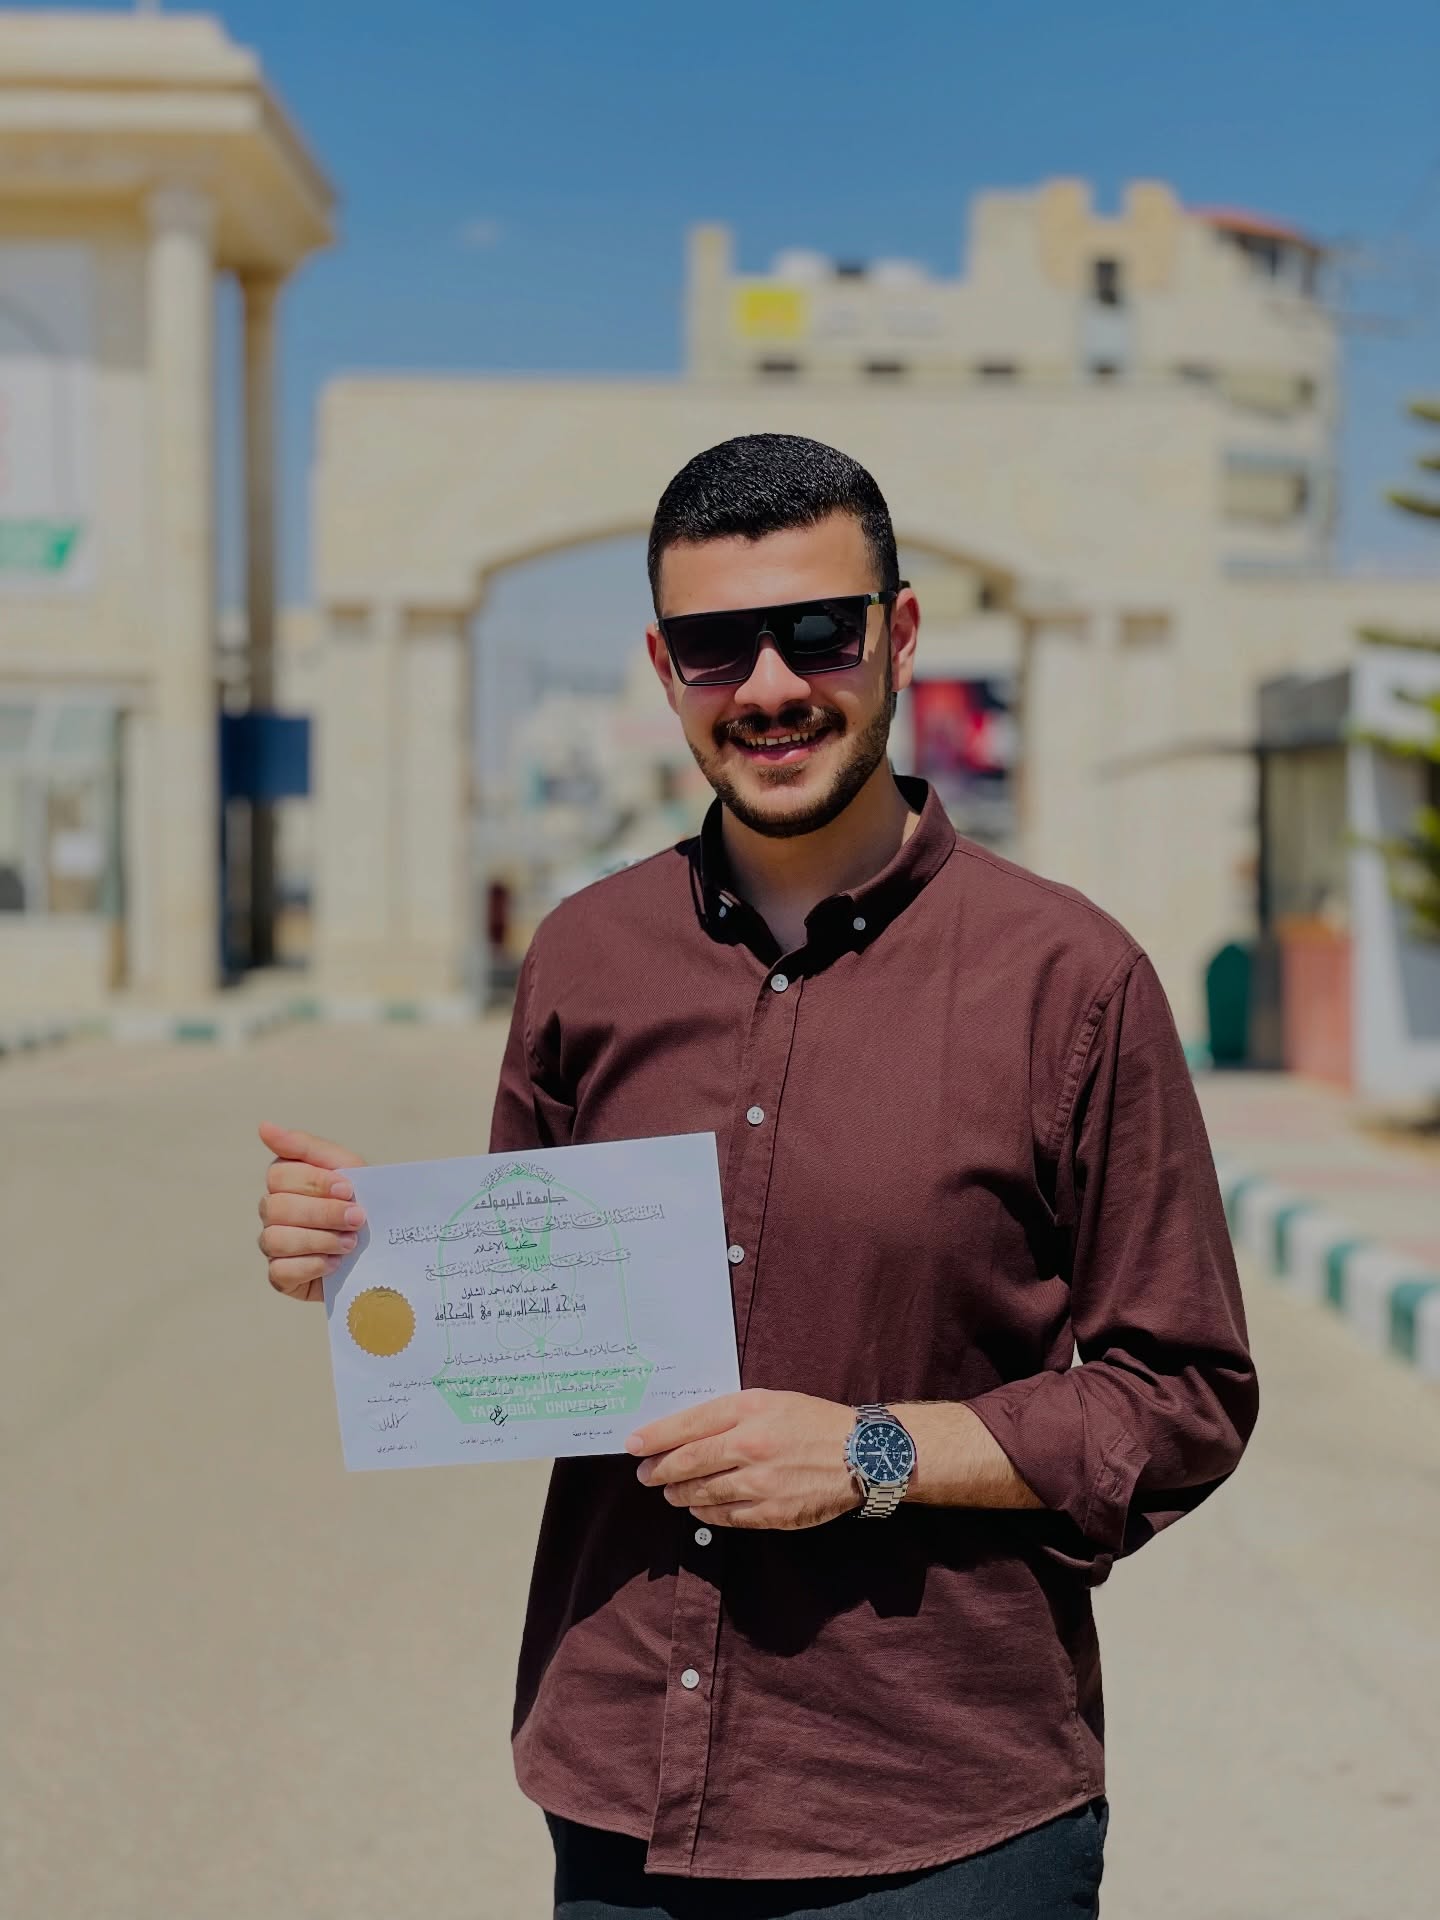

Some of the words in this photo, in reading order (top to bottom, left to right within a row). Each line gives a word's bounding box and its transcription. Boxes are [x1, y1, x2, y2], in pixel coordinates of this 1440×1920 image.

[473, 1190, 524, 1211] اليرموك
[526, 1188, 568, 1206] جامعة
[461, 1287, 485, 1300] الشلول
[540, 1283, 558, 1292] محمد
[470, 1401, 536, 1418] YAROUK
